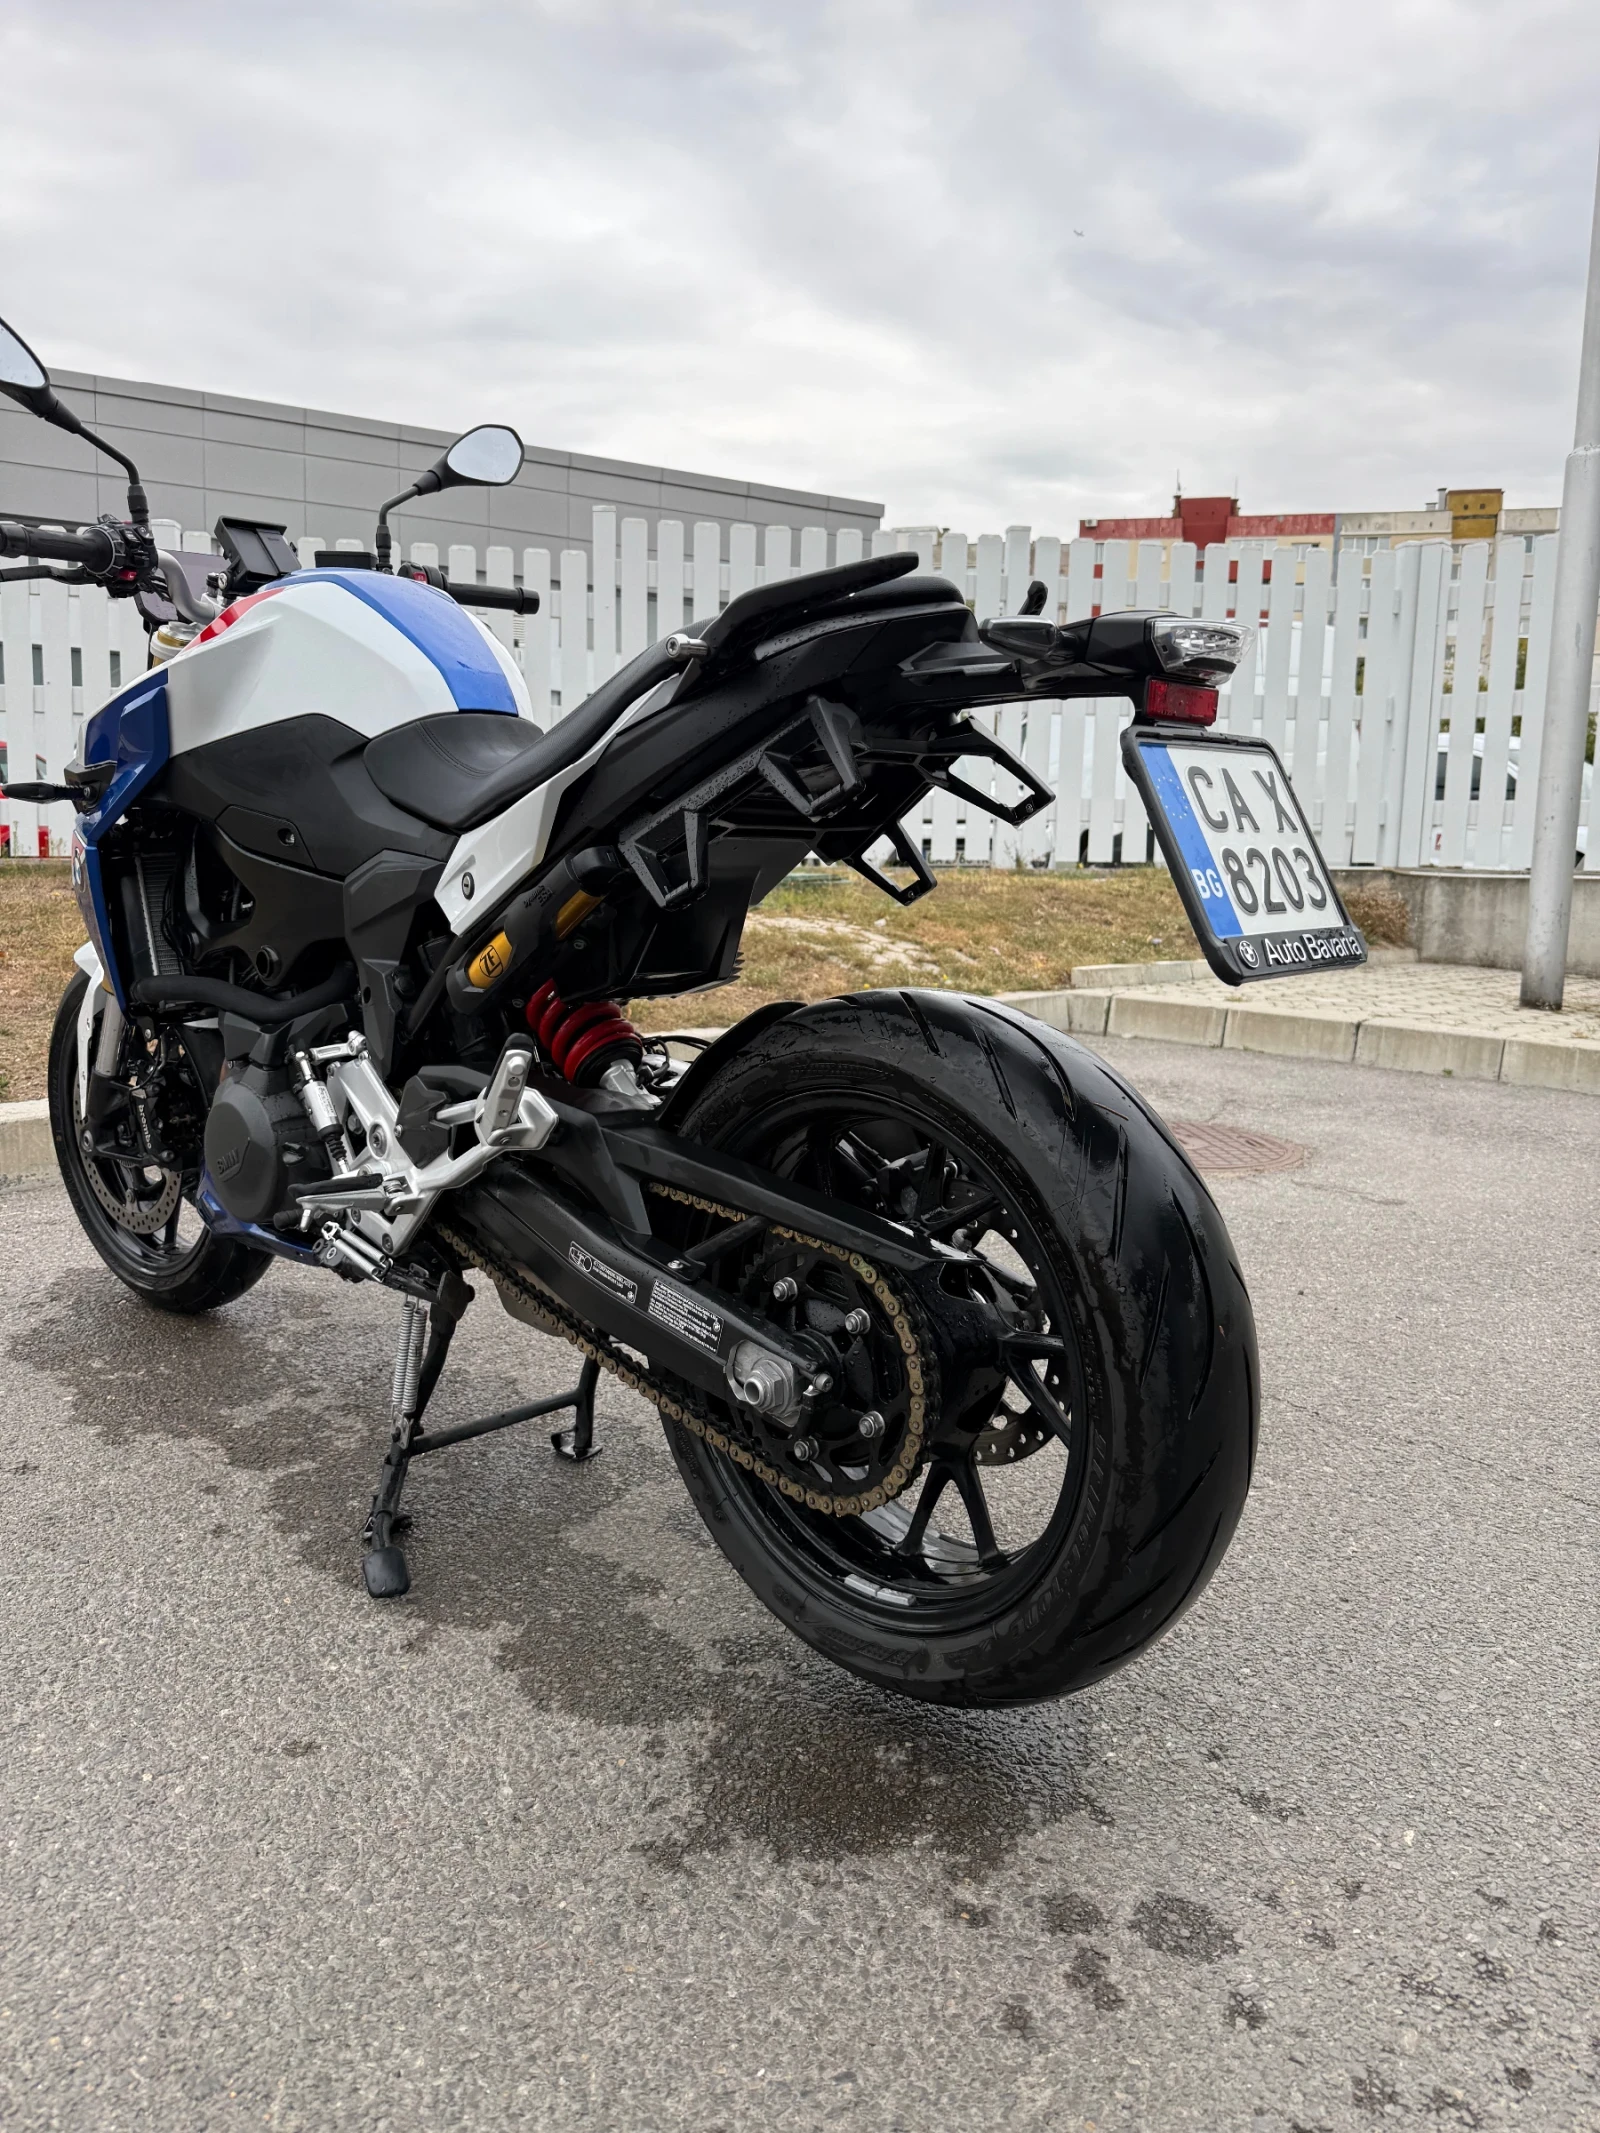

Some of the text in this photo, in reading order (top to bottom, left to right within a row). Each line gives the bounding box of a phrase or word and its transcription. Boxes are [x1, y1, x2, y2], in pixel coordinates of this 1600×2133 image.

[1188, 766, 1298, 833] CA X
[1192, 869, 1224, 899] BG
[1222, 847, 1327, 914] 8203
[480, 948, 502, 976] ZF
[1264, 938, 1306, 965] Auto
[1303, 932, 1362, 960] Bavaria
[139, 1104, 152, 1149] brembo
[216, 1148, 241, 1175] BMW
